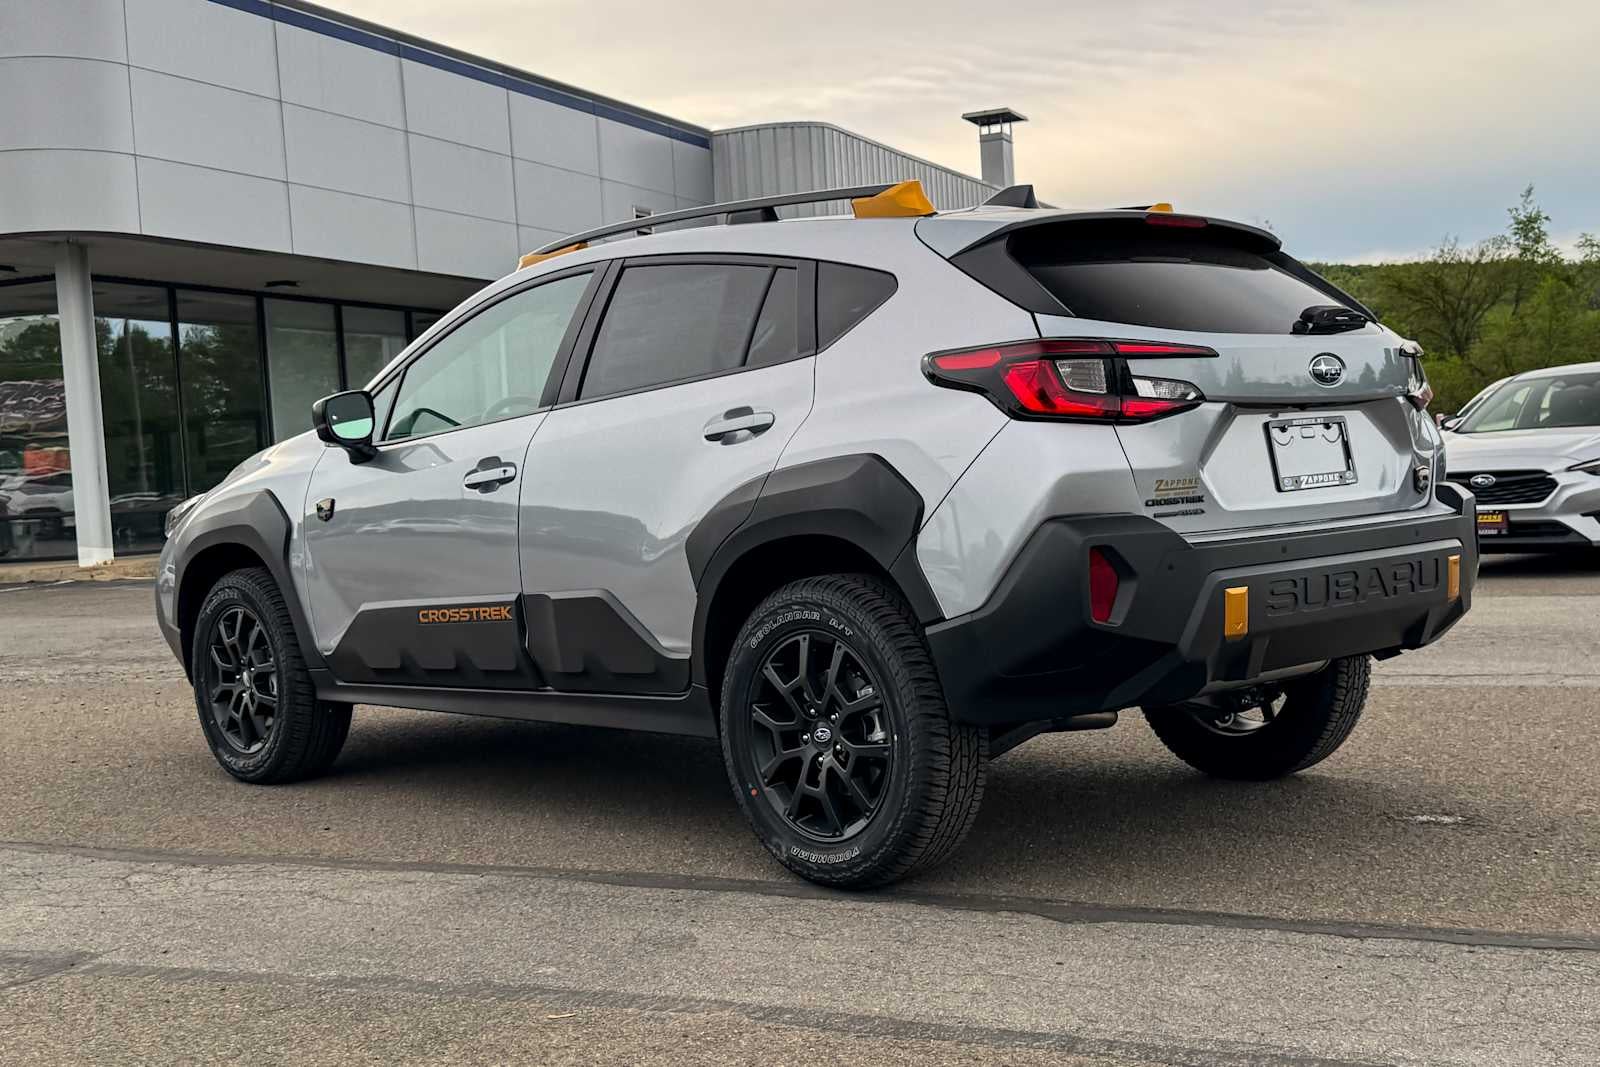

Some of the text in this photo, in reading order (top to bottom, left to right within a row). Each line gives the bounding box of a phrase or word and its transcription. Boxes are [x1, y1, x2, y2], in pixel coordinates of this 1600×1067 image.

[1154, 478, 1200, 492] ZAPPONE
[1300, 473, 1340, 488] ZAPPONE
[1145, 495, 1206, 507] CROSSTREK
[1264, 557, 1441, 617] SUBARU
[418, 605, 513, 623] CROSSTREK
[750, 610, 854, 649] GEOLANDAR A/T
[790, 846, 861, 864] YOKOHAMA
